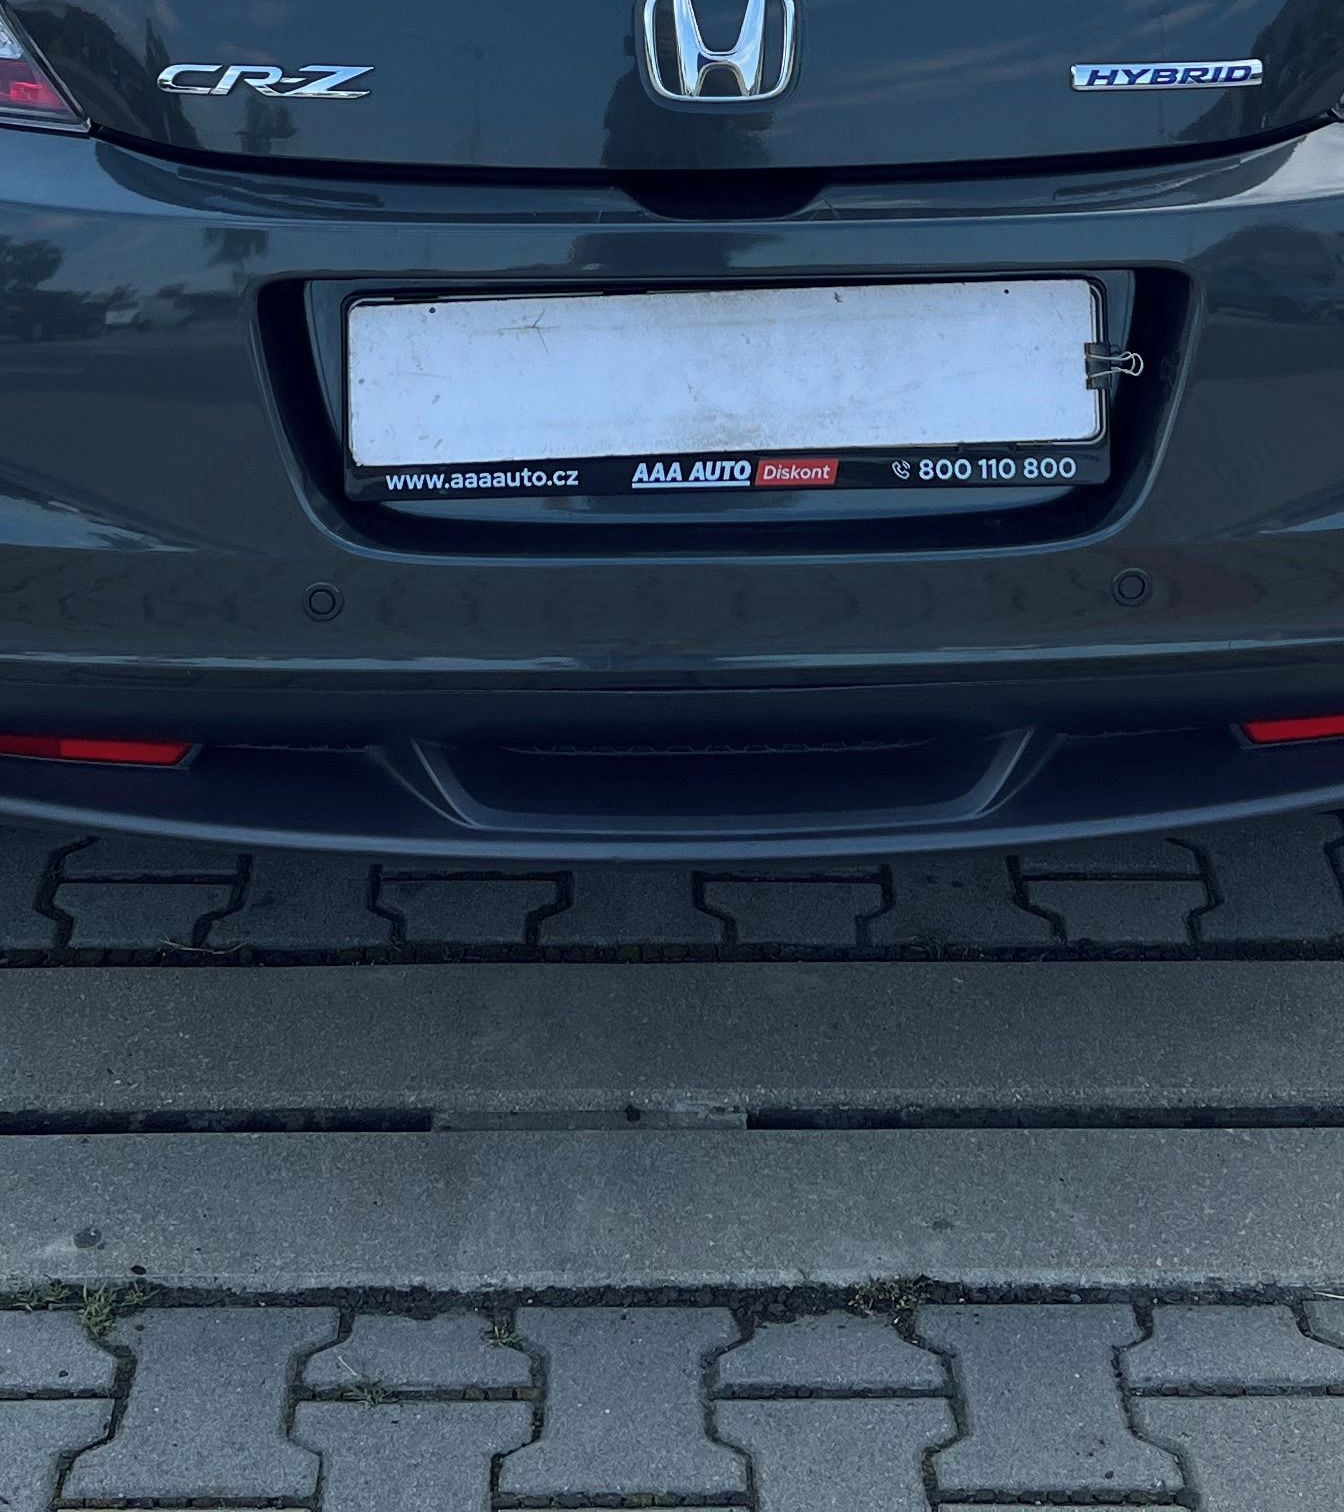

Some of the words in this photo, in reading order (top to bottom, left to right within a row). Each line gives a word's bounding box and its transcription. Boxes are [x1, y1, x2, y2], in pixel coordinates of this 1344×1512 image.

[157, 64, 375, 99] CR-Z
[1086, 65, 1252, 87] HYBRID
[385, 468, 579, 491] www.aaaauto.cz
[632, 462, 683, 482] AAA
[688, 460, 752, 481] AUTO
[763, 464, 831, 480] Diskont
[919, 458, 972, 480] 800
[978, 458, 1016, 479] 110
[1023, 457, 1077, 479] 800
